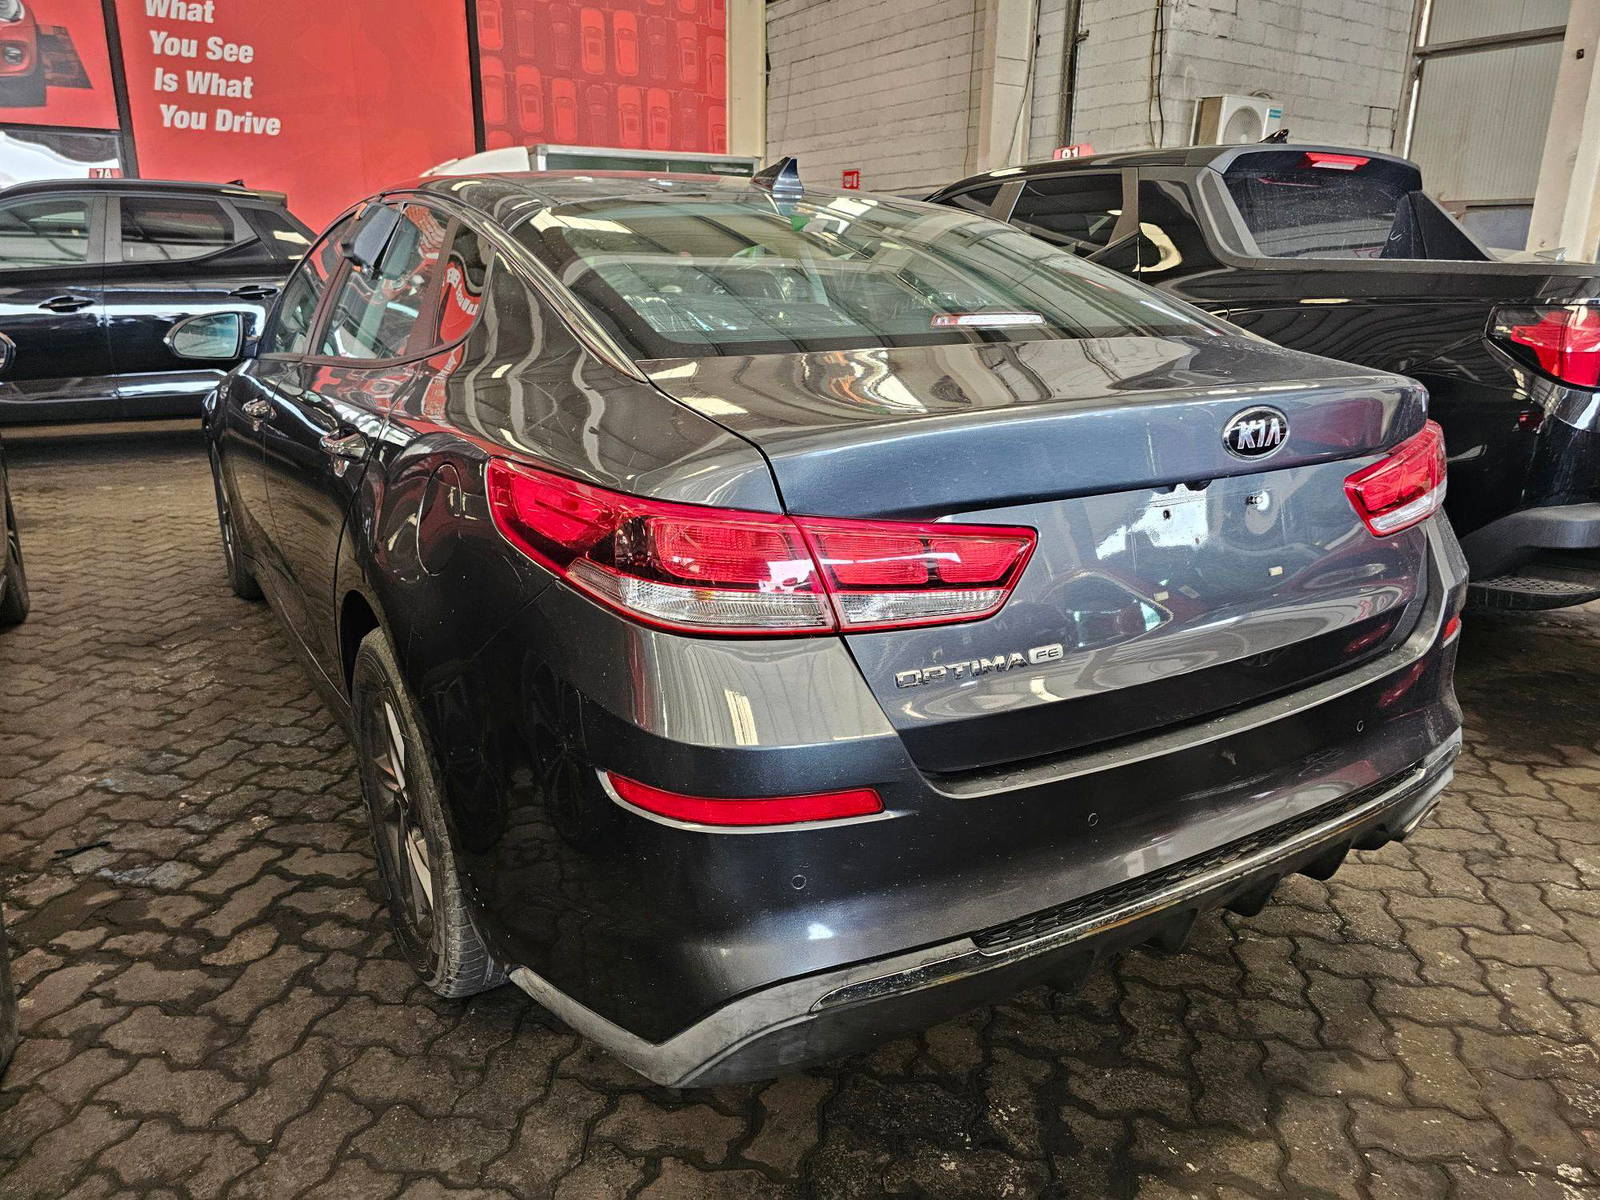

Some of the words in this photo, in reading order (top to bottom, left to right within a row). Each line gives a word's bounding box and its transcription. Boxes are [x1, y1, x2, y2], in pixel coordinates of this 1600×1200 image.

[145, 0, 215, 24] What
[149, 30, 198, 58] You
[206, 36, 254, 64] See
[153, 67, 179, 92] Is
[186, 70, 254, 99] What
[159, 103, 208, 130] You
[215, 108, 282, 136] Drive
[1232, 417, 1281, 450] KIA
[894, 652, 1030, 689] OPTIMA
